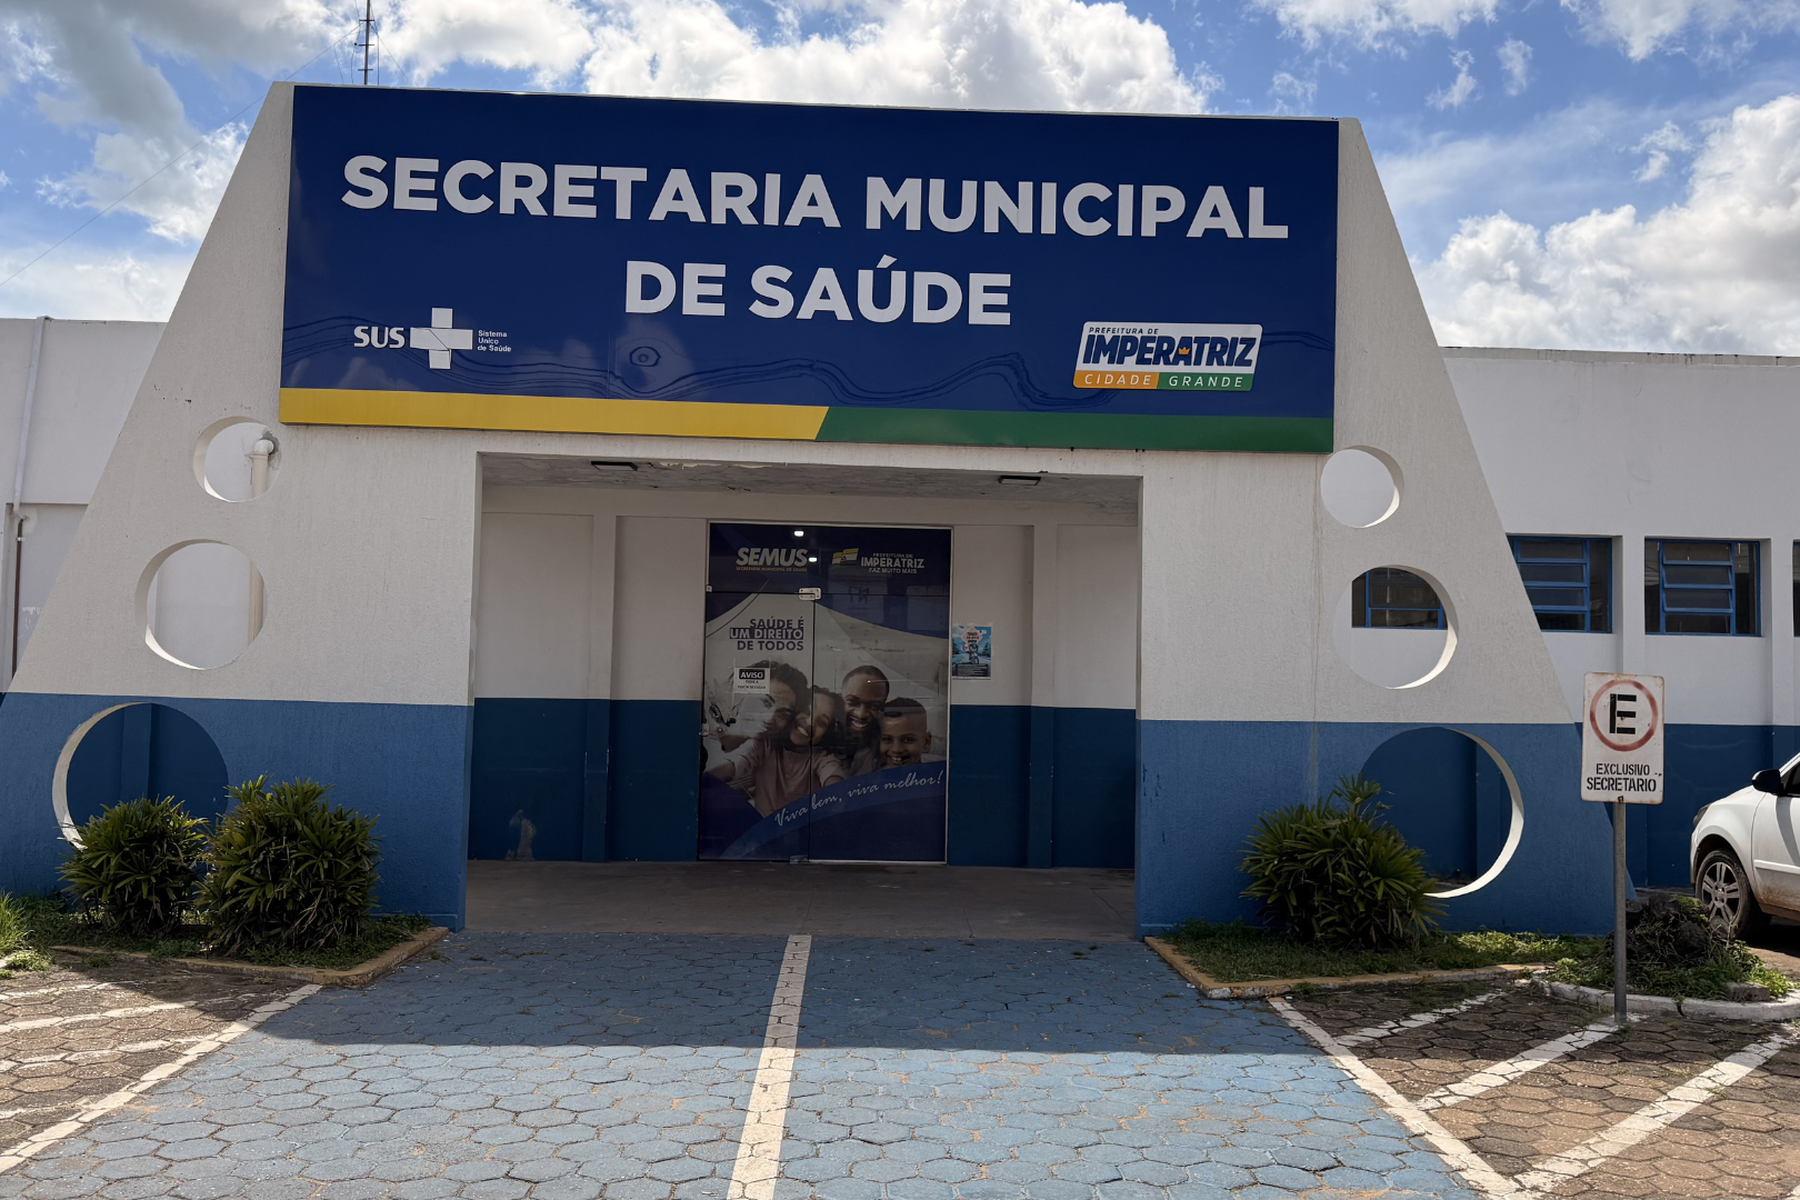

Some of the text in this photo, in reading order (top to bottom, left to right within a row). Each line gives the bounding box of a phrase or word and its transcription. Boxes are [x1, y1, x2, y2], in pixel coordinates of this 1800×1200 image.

[341, 154, 1289, 239] SECRETARIA MUNICIPAL
[625, 254, 1011, 325] DE SAÚDE
[353, 325, 406, 349] SUS
[478, 329, 508, 338] Sistema
[1088, 327, 1144, 335] PREFEITURA
[488, 344, 512, 353] Saúde
[1082, 334, 1257, 367] IMPERATRIZ
[1084, 373, 1243, 388] CIDADE GRANDE
[736, 547, 808, 567] SEMUS
[861, 556, 925, 569] IMPERATRIZ
[749, 616, 805, 629] SAÚDE É
[730, 629, 803, 640] UM DIREITO
[737, 640, 804, 651] DE TODOS
[740, 671, 764, 679] AVISO
[1609, 693, 1637, 734] E
[1595, 763, 1651, 776] EXCLUSIVO
[1586, 776, 1657, 792] SECRETARIO
[774, 770, 944, 827] Viva bem, viva melhor!
